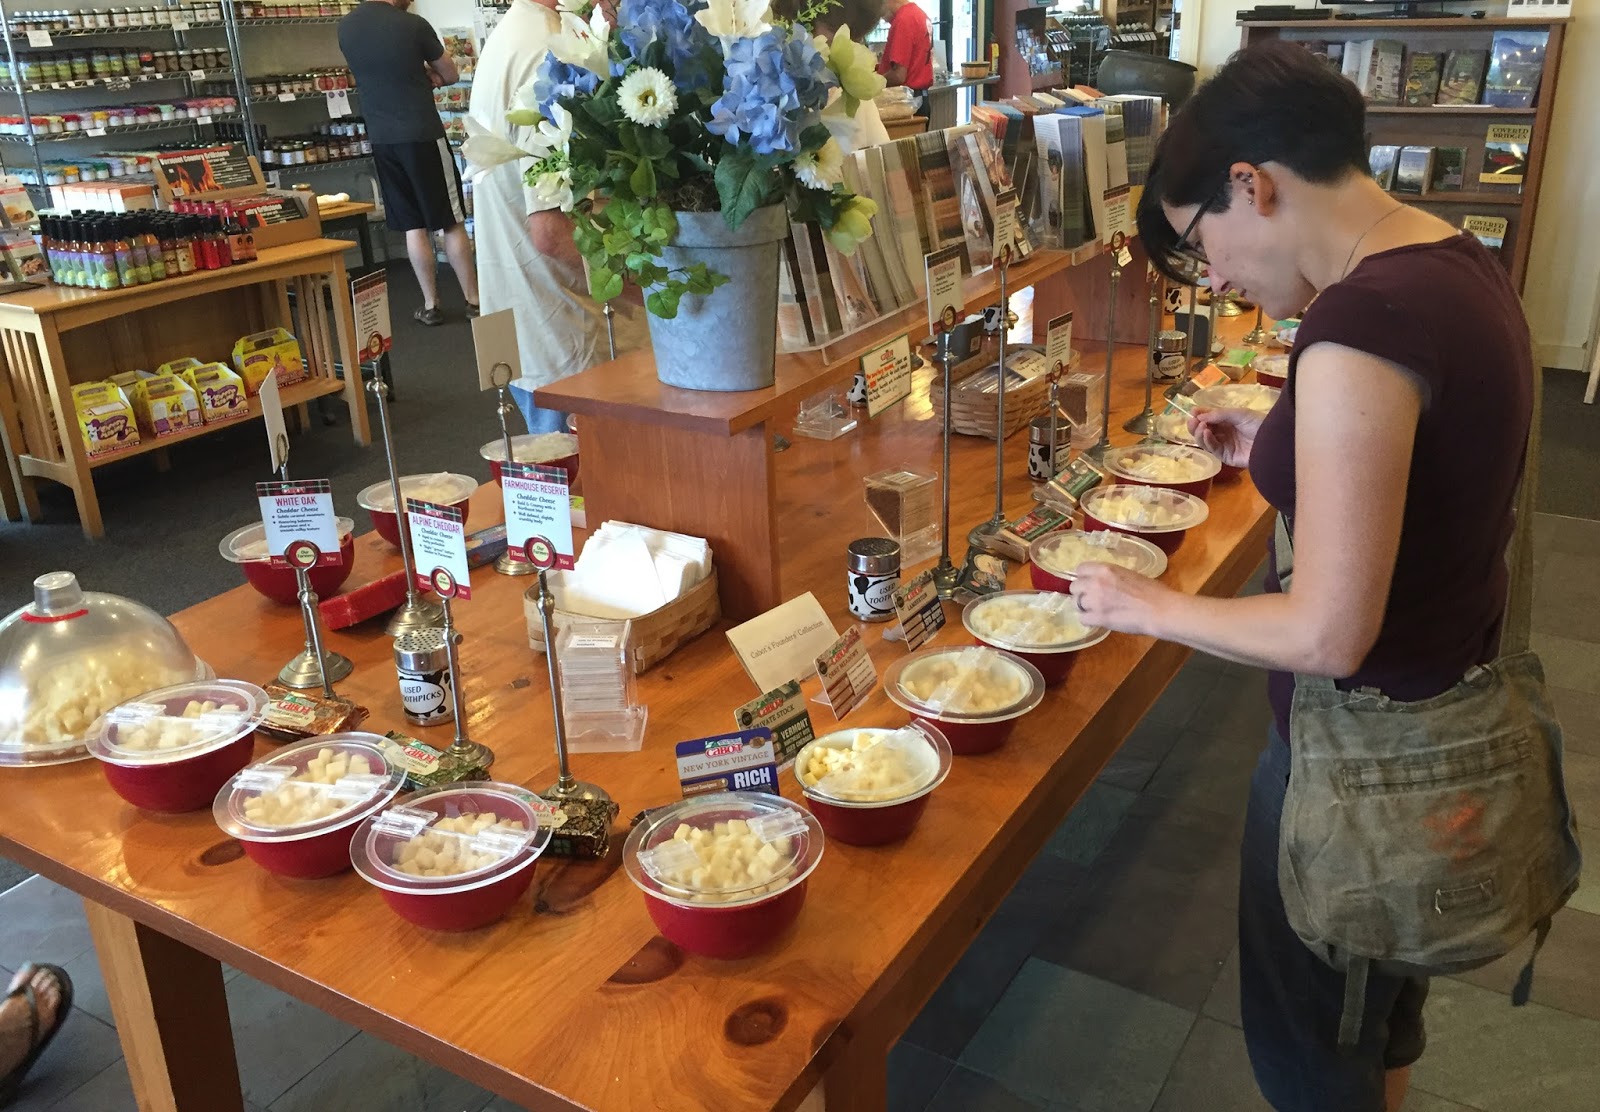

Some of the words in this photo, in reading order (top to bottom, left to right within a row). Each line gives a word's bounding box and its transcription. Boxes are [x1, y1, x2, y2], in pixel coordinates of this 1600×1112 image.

[1469, 220, 1504, 229] COVERED
[1469, 225, 1502, 233] BRIDGES
[505, 479, 539, 492] FARMHOUSE
[541, 485, 566, 496] RESERVE
[275, 498, 299, 506] WHITE
[301, 496, 317, 505] OAK
[517, 493, 538, 501] Cheddar
[412, 516, 433, 527] ALPINE
[434, 520, 460, 533] CHEDDAR
[421, 528, 438, 536] Cheddar
[880, 582, 896, 594] USED
[750, 644, 772, 659] Cabot's
[771, 631, 797, 648] Founders'
[797, 621, 824, 636] Collection
[777, 704, 795, 718] STOCK
[781, 718, 809, 740] VERMONT
[683, 763, 704, 773] NEW
[705, 758, 729, 769] YORK
[731, 751, 769, 763] VINTAGE
[734, 767, 771, 789] RICH
